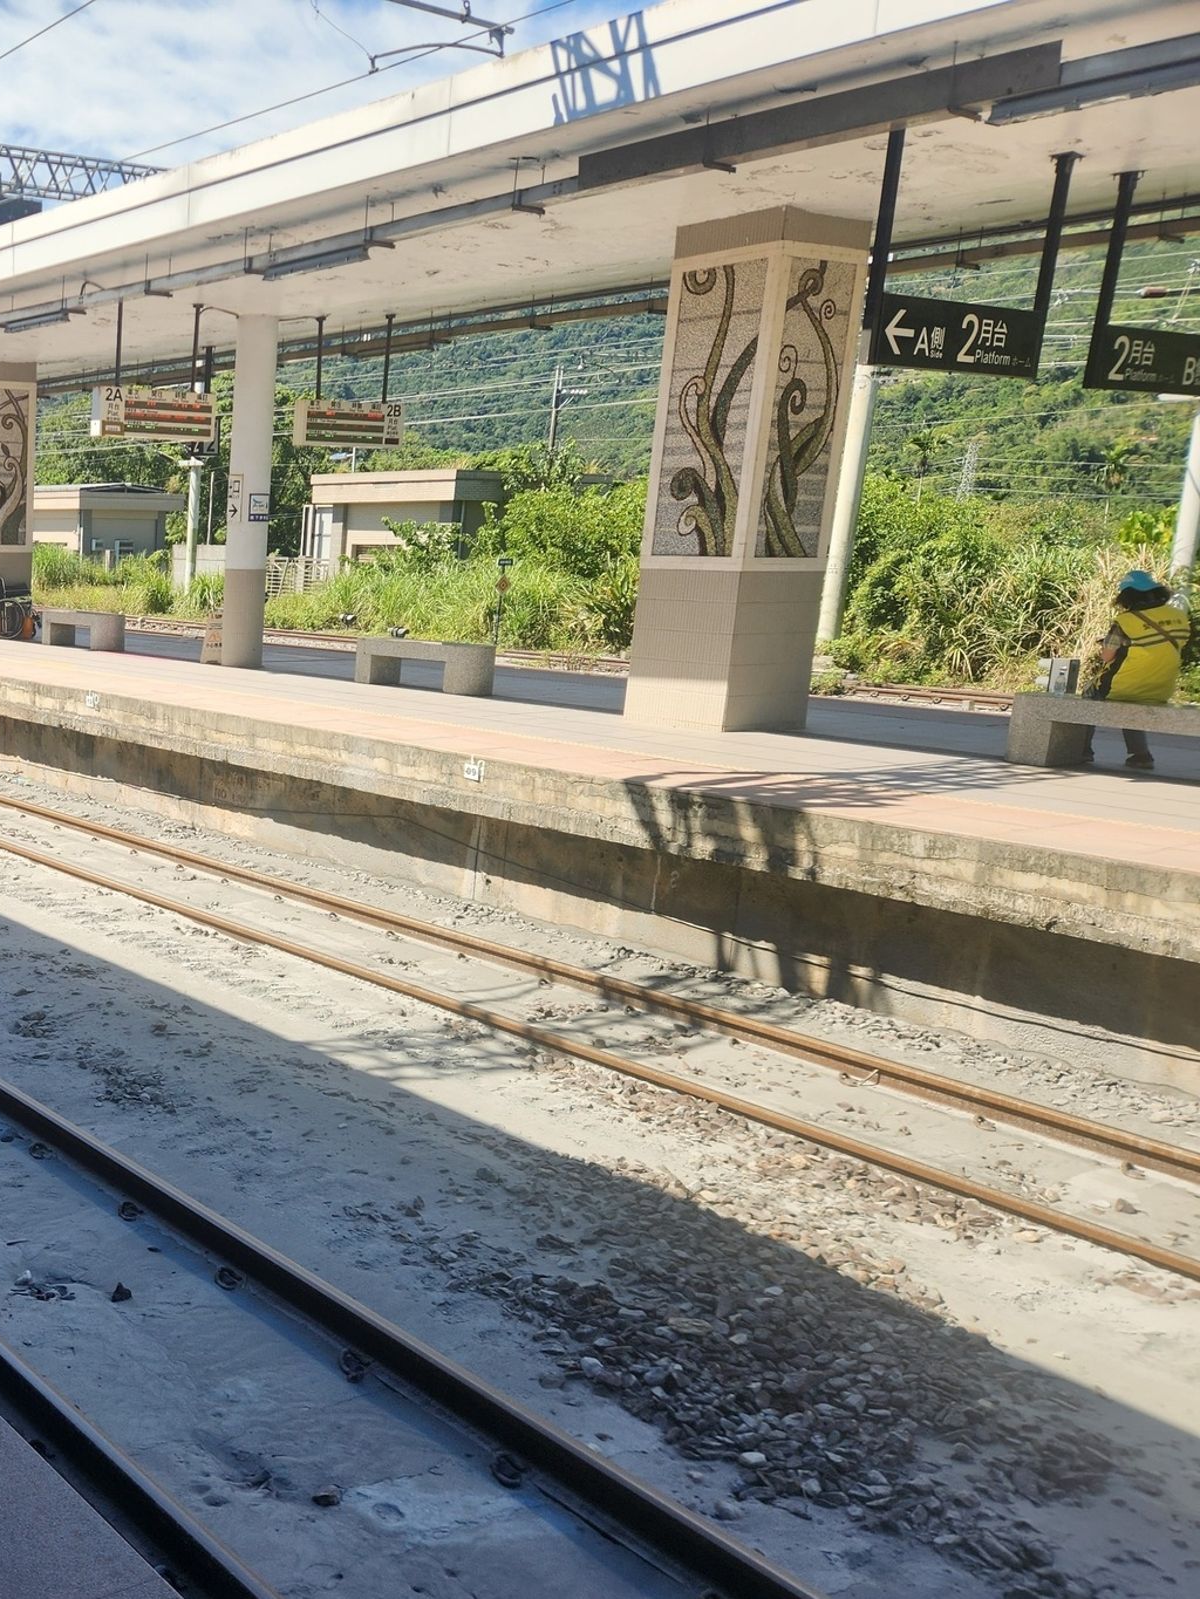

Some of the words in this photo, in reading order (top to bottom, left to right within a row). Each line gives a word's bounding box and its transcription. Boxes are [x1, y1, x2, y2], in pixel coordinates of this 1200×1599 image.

[913, 326, 946, 356] A側
[956, 313, 1008, 363] 2月台
[975, 349, 1011, 366] Platform
[1108, 335, 1155, 381] 2月台
[1182, 357, 1200, 385] B
[106, 388, 123, 402] 2A
[387, 404, 402, 418] 2B
